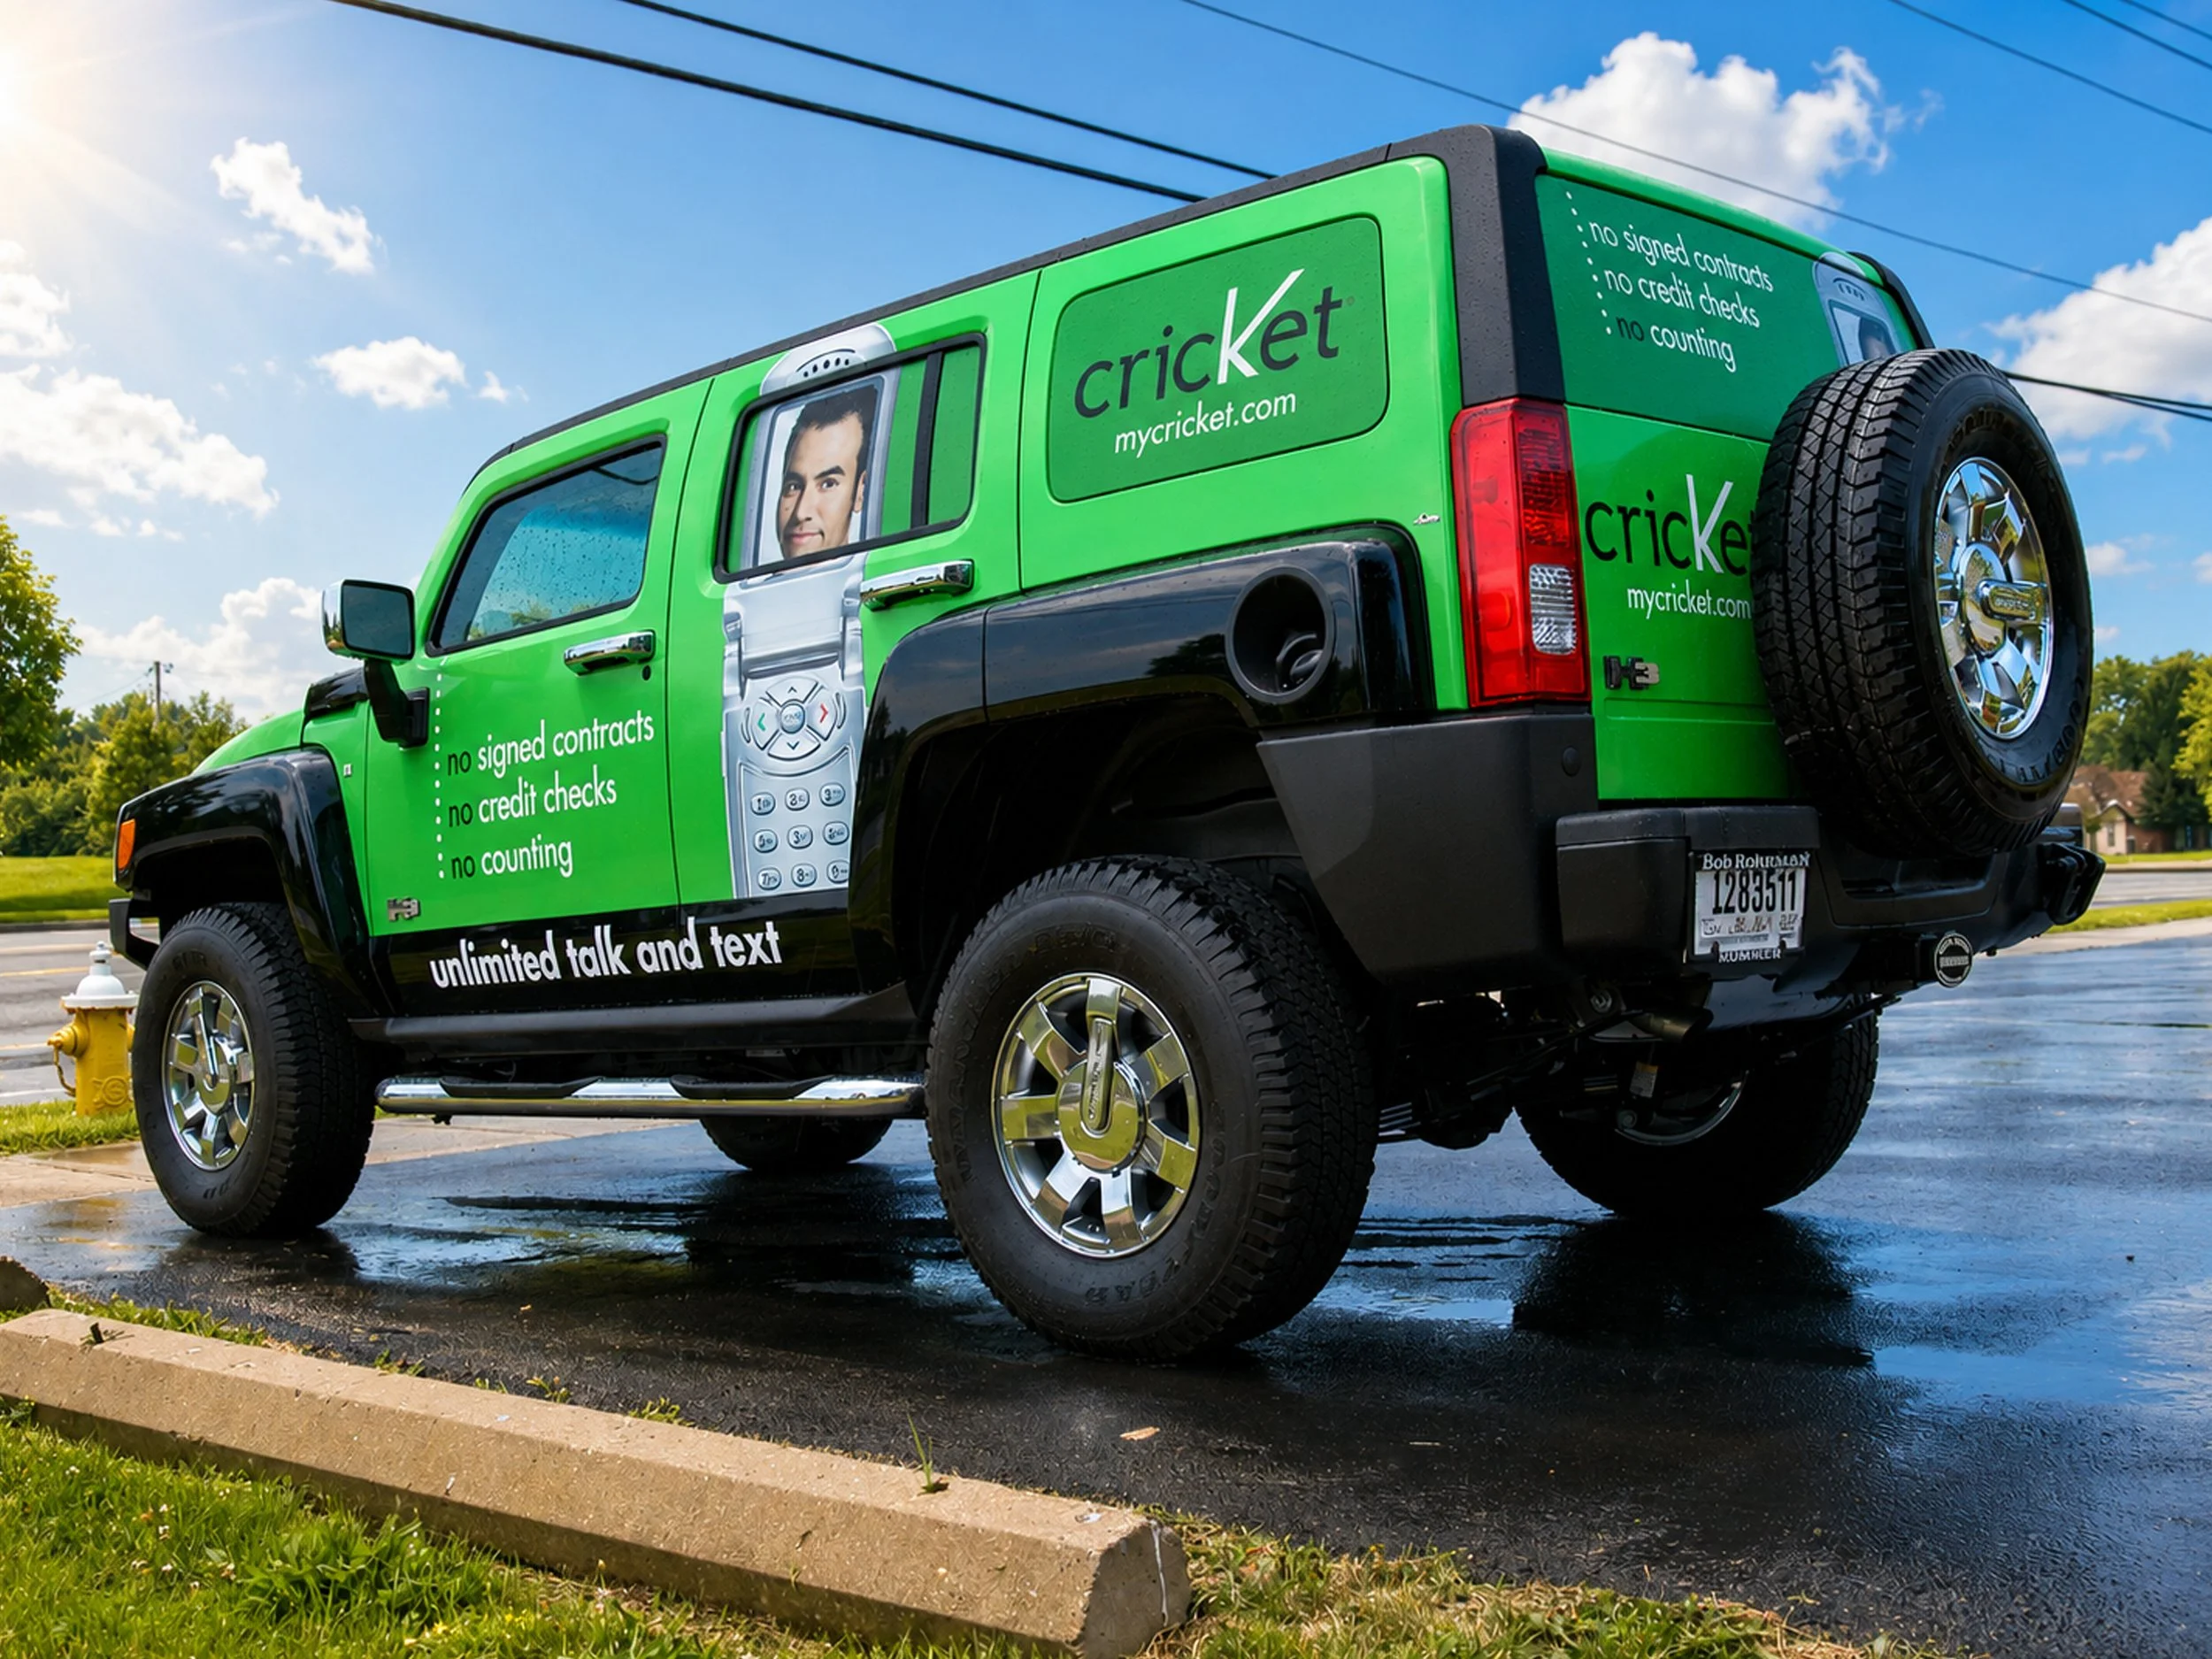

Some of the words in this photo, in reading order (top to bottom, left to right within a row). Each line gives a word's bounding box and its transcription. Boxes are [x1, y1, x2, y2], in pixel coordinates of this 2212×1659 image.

[1589, 220, 1618, 247] no
[1623, 224, 1690, 265] signed
[1694, 250, 1773, 293] contracts
[1603, 268, 1632, 295] no
[1638, 271, 1694, 311] credit
[1699, 284, 1760, 329] checks
[1617, 315, 1644, 342] no
[1650, 324, 1737, 373] counting
[1114, 393, 1296, 457] mycricket.com
[1627, 579, 1752, 619] mycricket.com
[448, 751, 472, 776] no
[478, 718, 545, 779] signed
[552, 710, 655, 757] contracts
[449, 803, 473, 827] no
[479, 776, 537, 823] credit
[543, 764, 618, 813] checks
[451, 856, 475, 879] no
[480, 833, 573, 878] counting
[1701, 853, 1732, 870] Bob
[1712, 868, 1796, 915] 1283511
[429, 929, 562, 988] unlimited
[565, 925, 631, 979] talk
[636, 916, 703, 973] and
[710, 921, 783, 967] text
